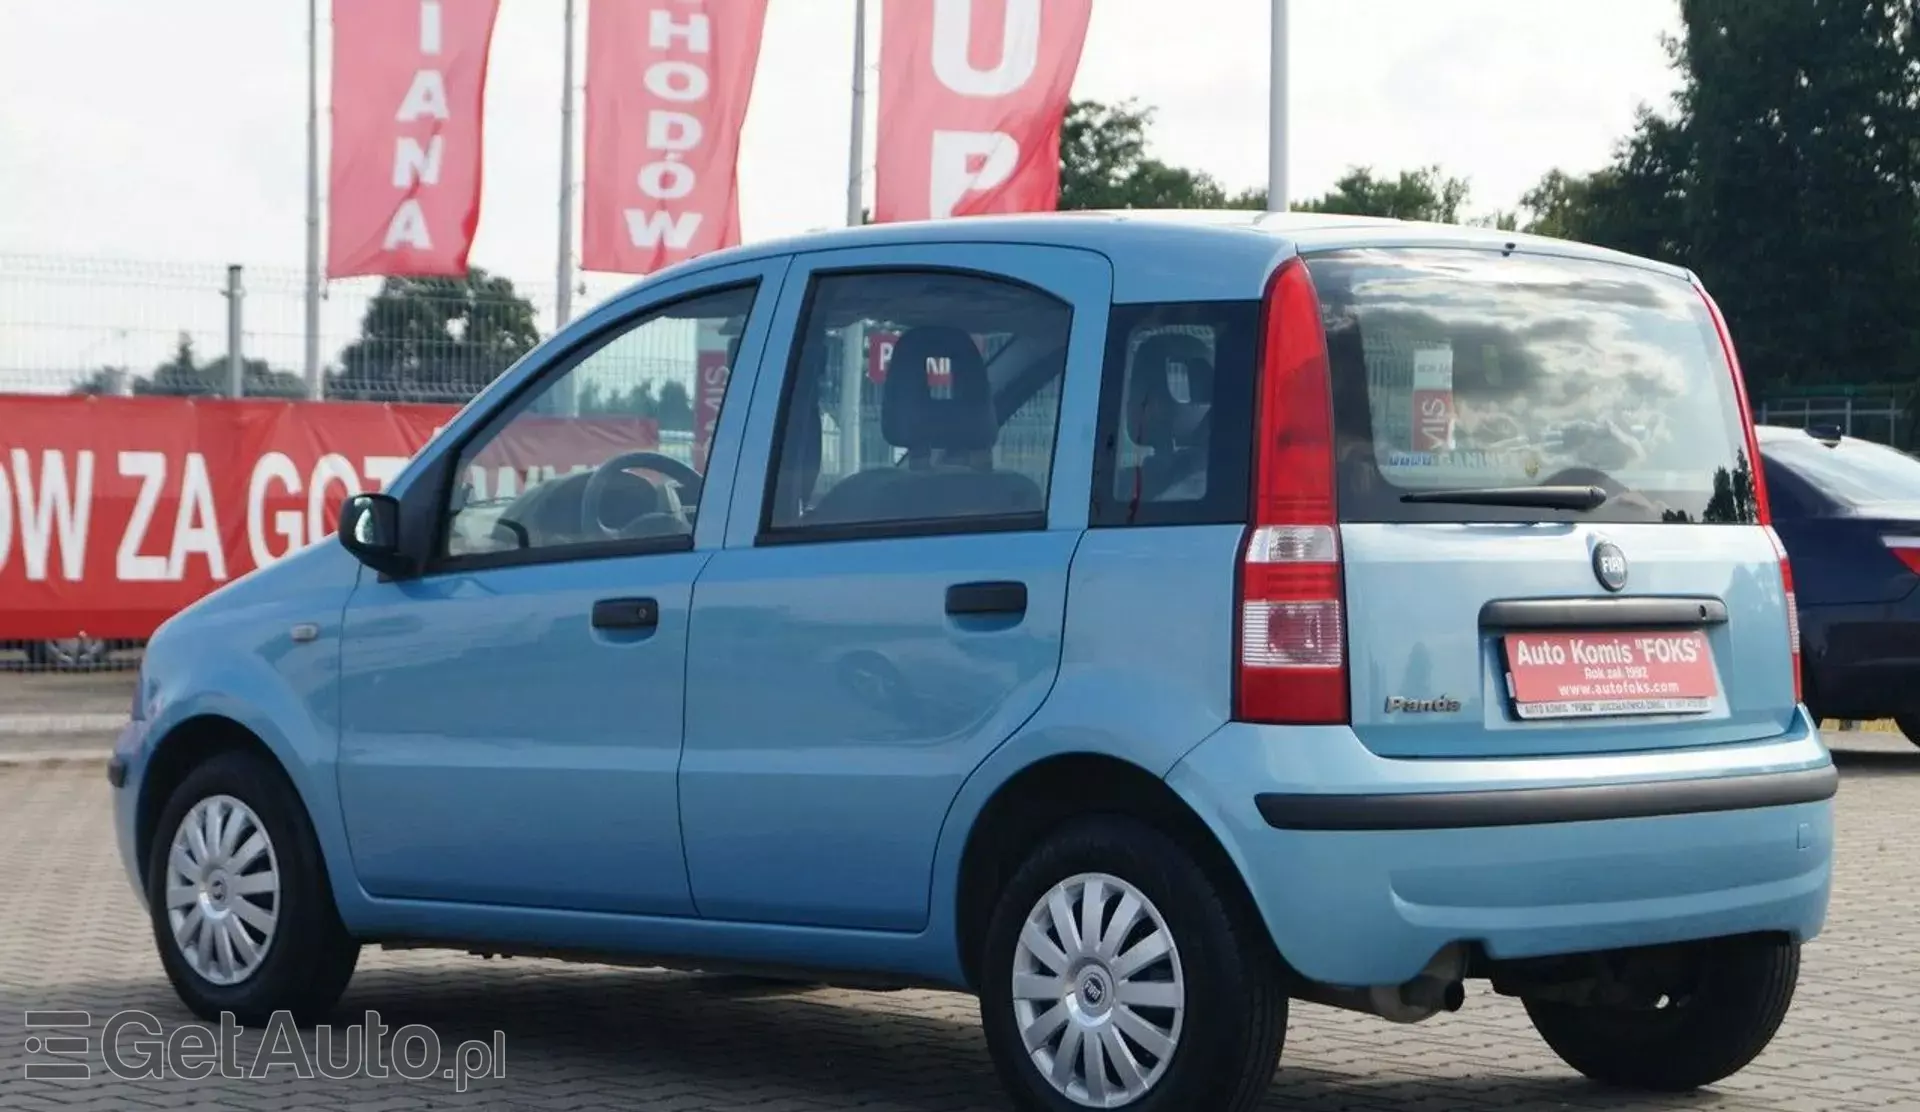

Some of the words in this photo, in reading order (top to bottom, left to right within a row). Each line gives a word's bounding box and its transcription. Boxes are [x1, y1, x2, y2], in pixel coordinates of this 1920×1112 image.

[623, 0, 710, 249] HODÓW
[0, 448, 95, 581] W
[116, 451, 228, 581] ZA
[1600, 556, 1625, 574] FIAT
[1517, 639, 1565, 666] Auto
[1569, 638, 1632, 665] Komis
[1635, 637, 1701, 662] "FOKS"
[1557, 681, 1680, 696] www.autofoks.com
[1384, 693, 1461, 713] Panda
